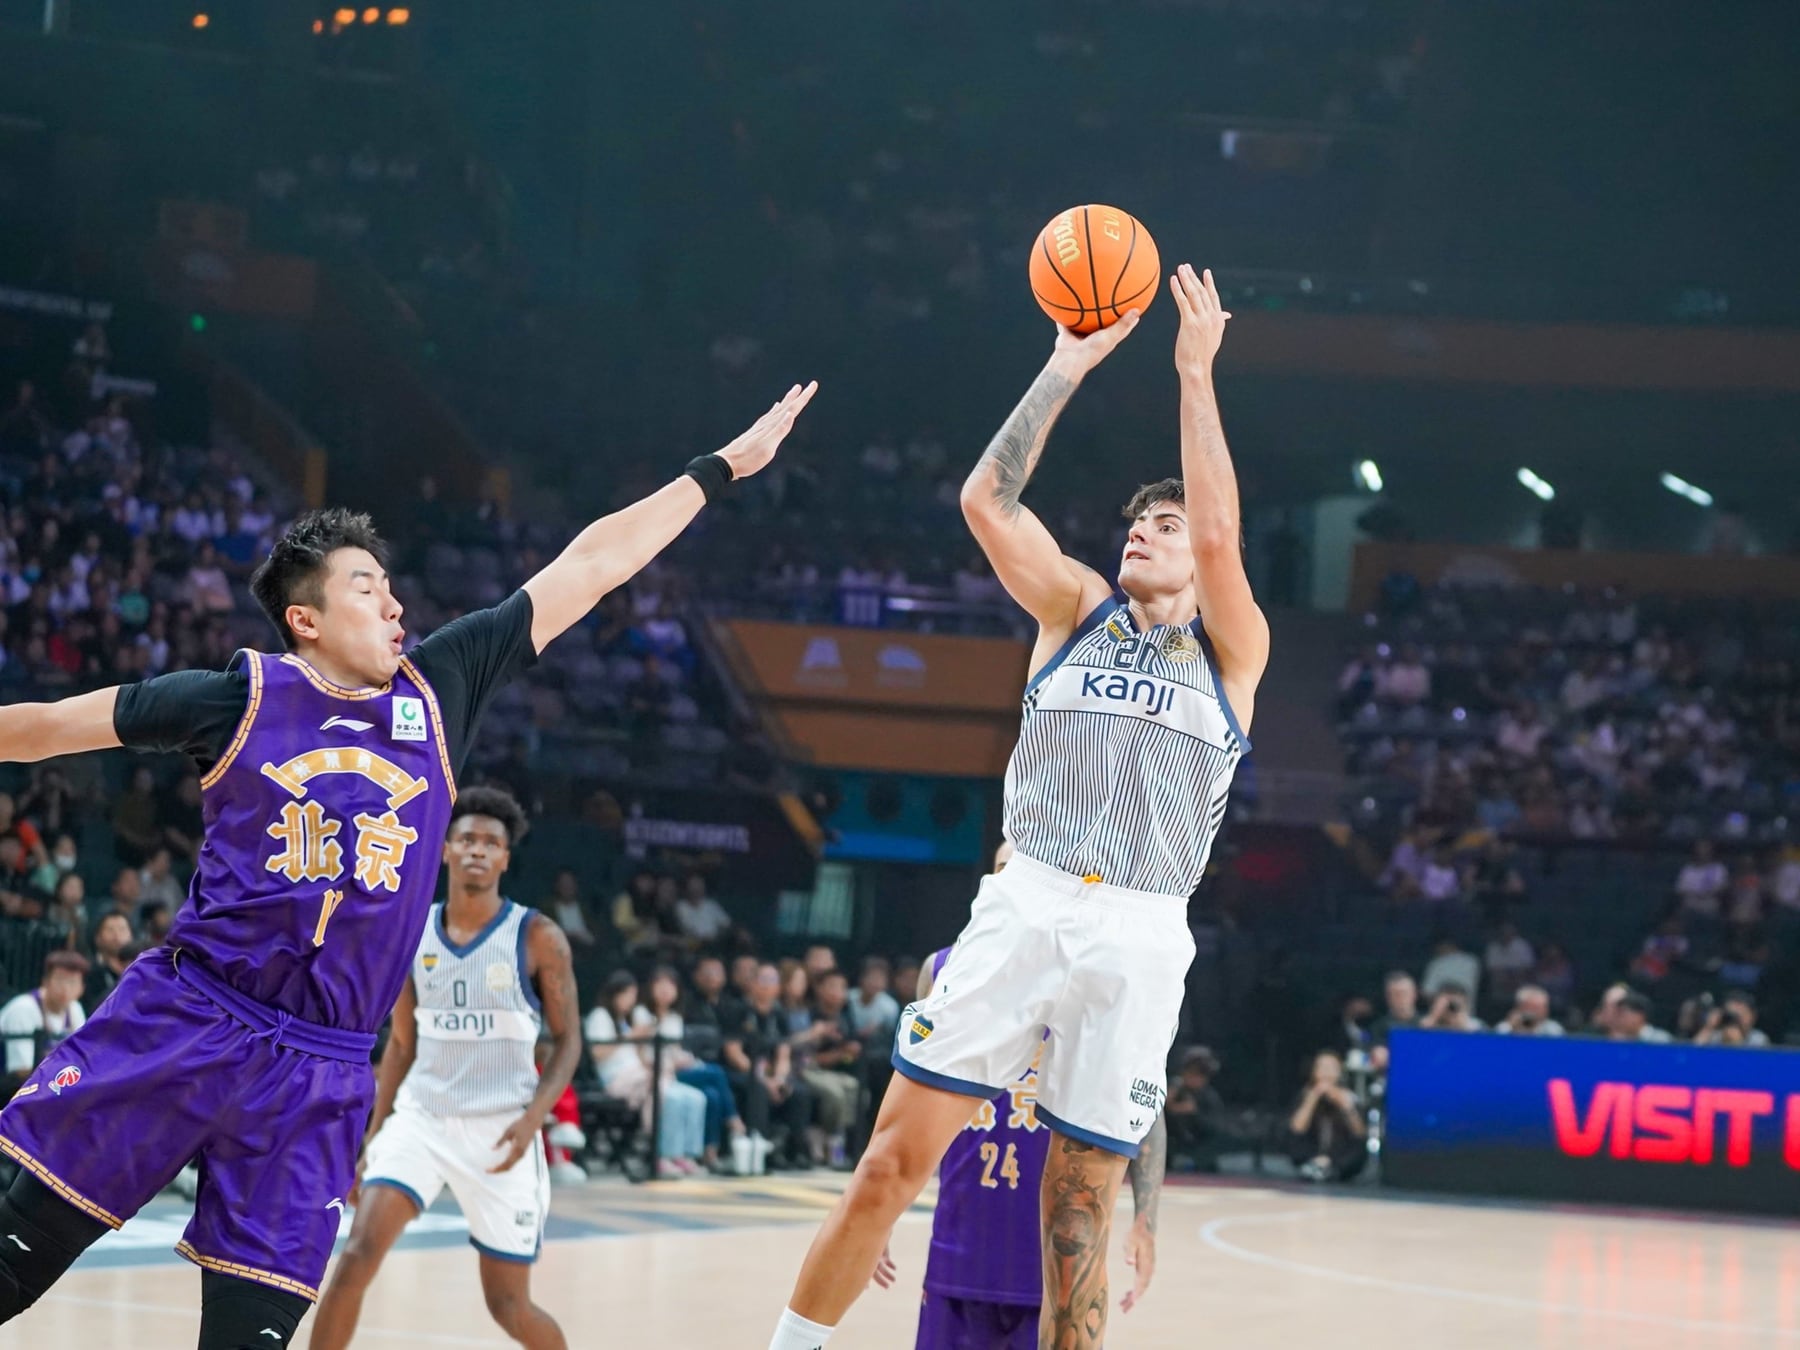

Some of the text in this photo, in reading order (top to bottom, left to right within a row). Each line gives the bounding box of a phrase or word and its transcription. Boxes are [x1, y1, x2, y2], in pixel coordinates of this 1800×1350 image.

[1053, 208, 1081, 268] Wil
[1114, 637, 1159, 676] 20
[265, 799, 419, 893] 北京
[1129, 1089, 1156, 1110] NEGRA
[1131, 1077, 1158, 1097] LOMA
[1548, 1078, 1774, 1167] VISIT
[980, 1142, 1021, 1190] 24
